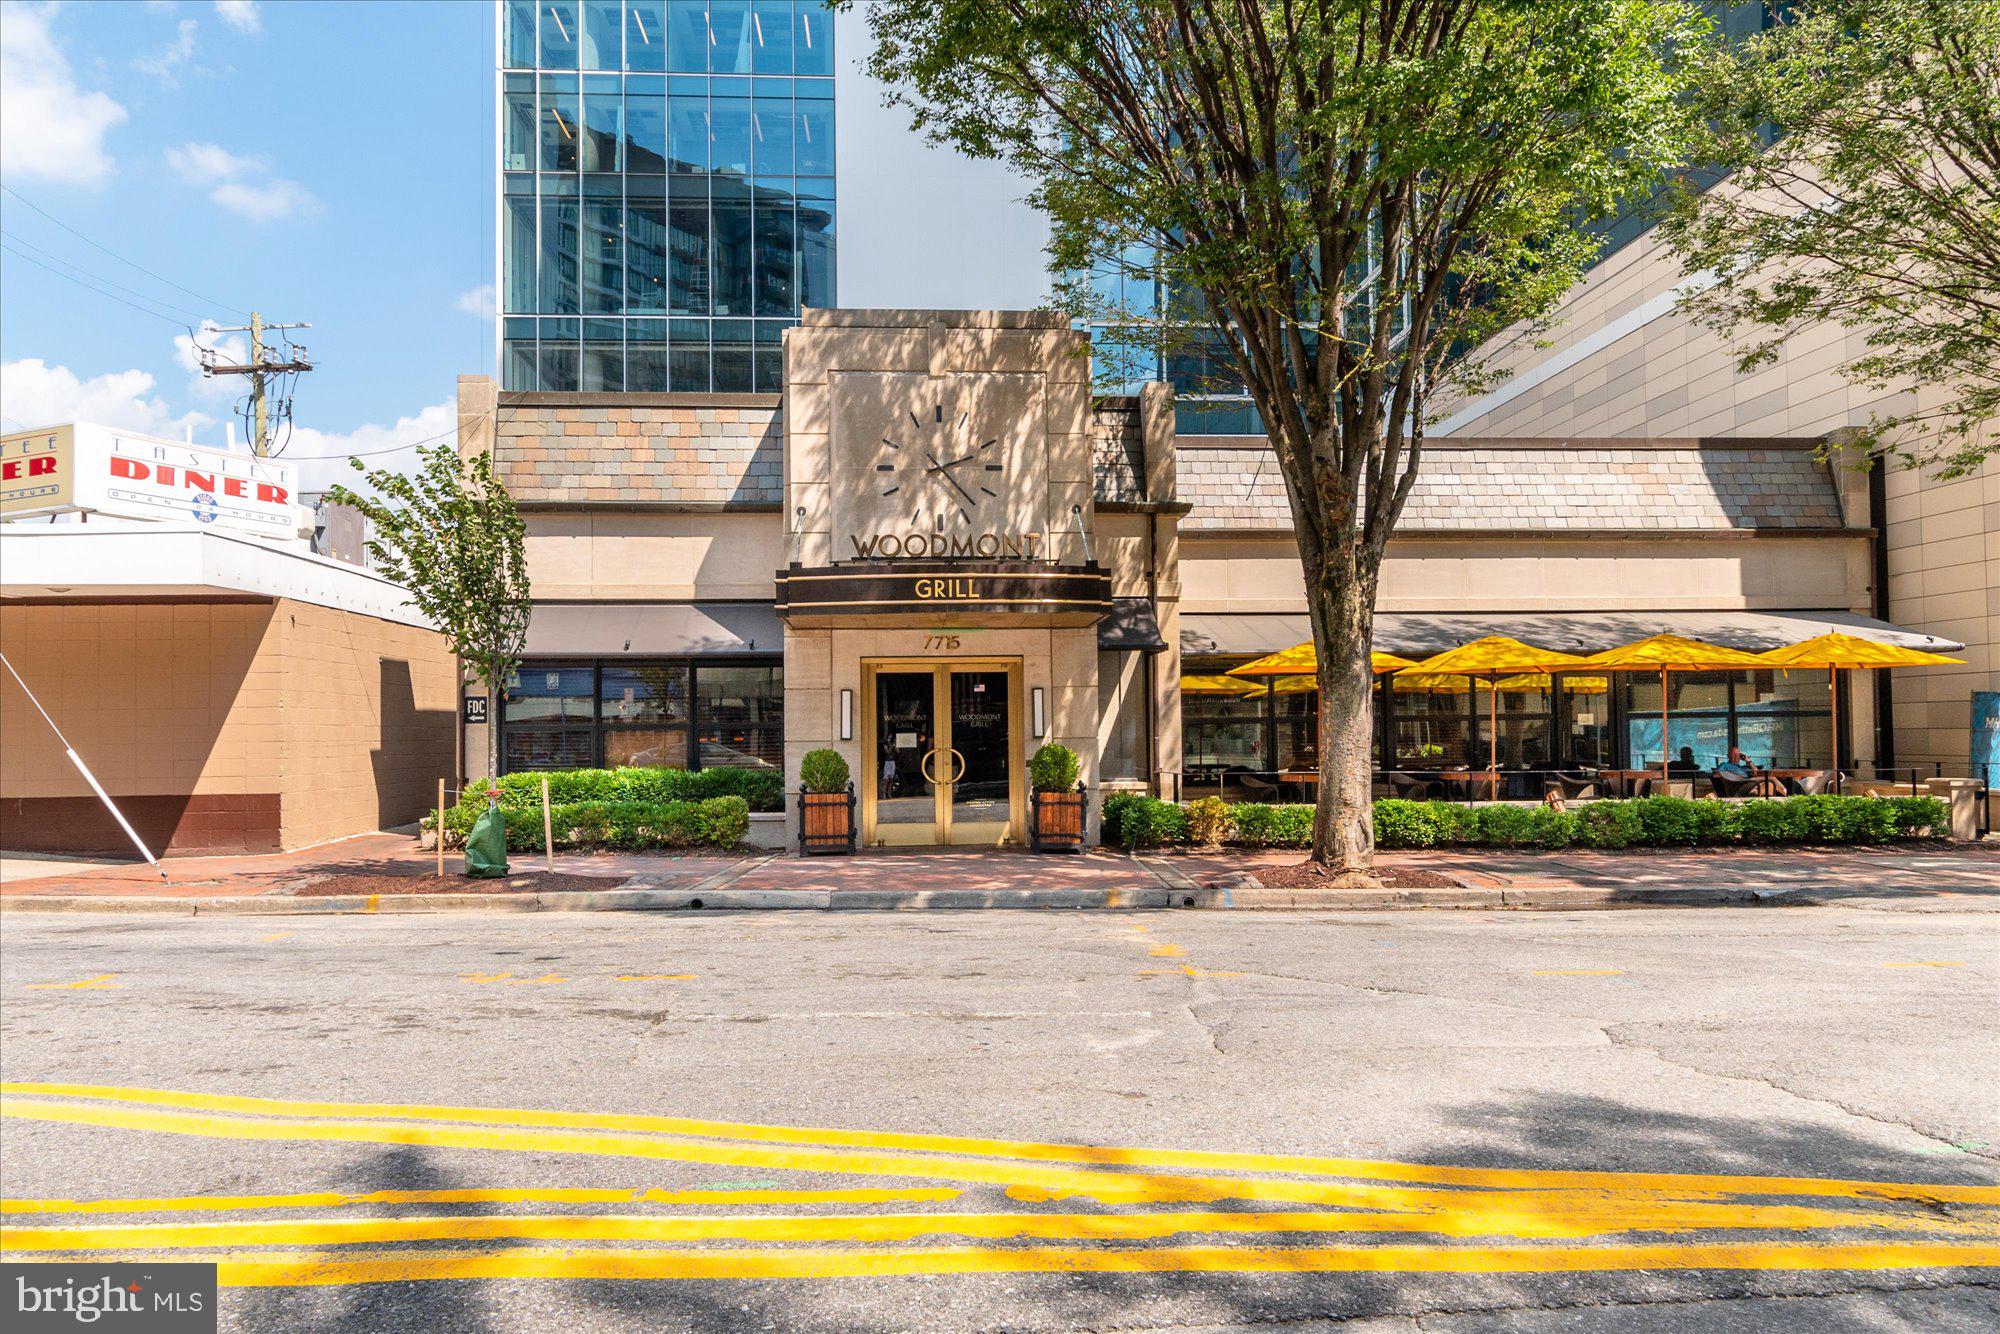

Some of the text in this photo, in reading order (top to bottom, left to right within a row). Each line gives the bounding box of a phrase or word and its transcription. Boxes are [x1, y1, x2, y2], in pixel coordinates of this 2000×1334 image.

[2, 456, 57, 480] ER
[110, 456, 289, 505] DINER
[112, 491, 171, 505] OPEN
[851, 533, 1040, 558] WOODMONT
[914, 579, 980, 598] GRILL
[924, 635, 960, 650] 7715
[467, 700, 485, 714] FDC
[959, 713, 1001, 721] WOODMONT
